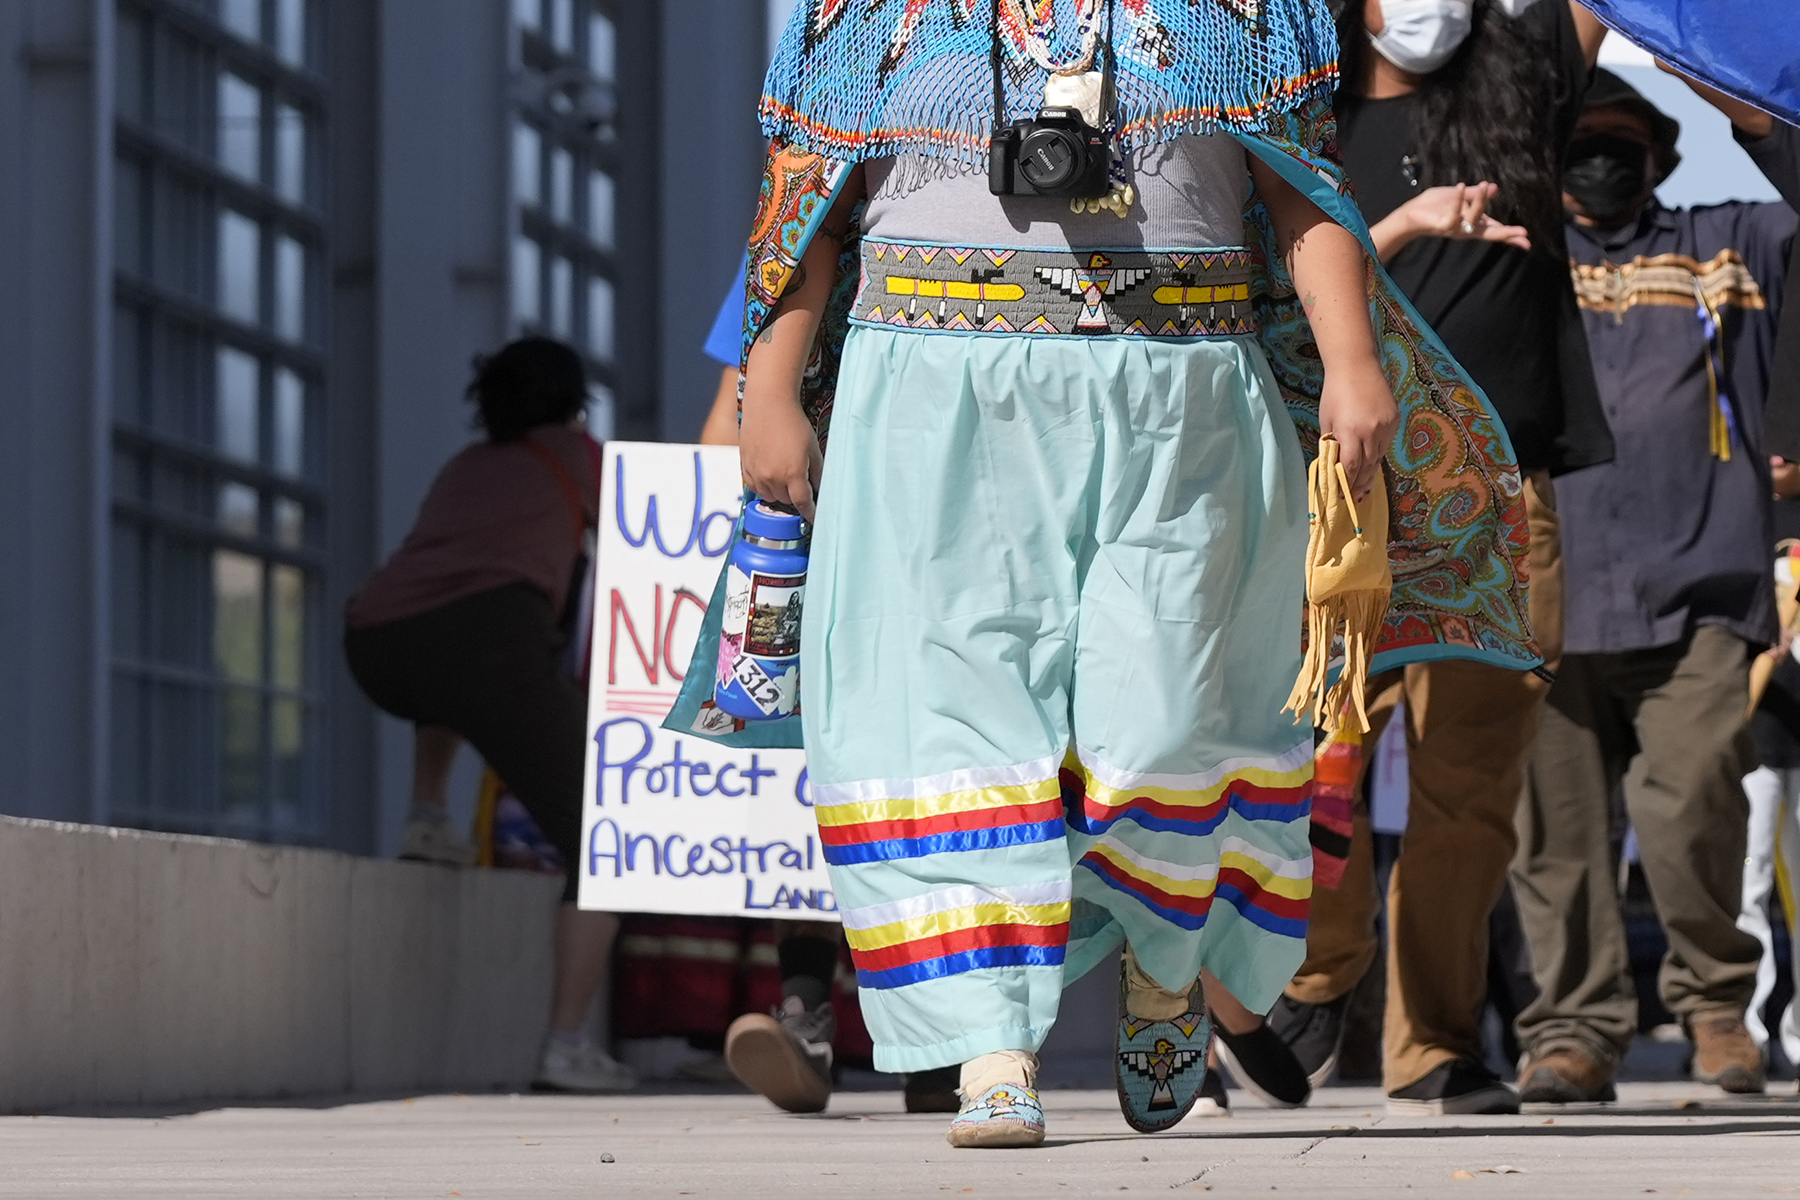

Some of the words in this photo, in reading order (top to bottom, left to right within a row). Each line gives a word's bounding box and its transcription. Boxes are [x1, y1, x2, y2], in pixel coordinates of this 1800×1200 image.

[1041, 110, 1067, 118] Canon
[1037, 148, 1055, 171] Canon
[616, 451, 743, 557] Wa
[732, 655, 780, 707] 1312
[594, 716, 777, 806] Protect
[589, 818, 814, 877] Ancestral
